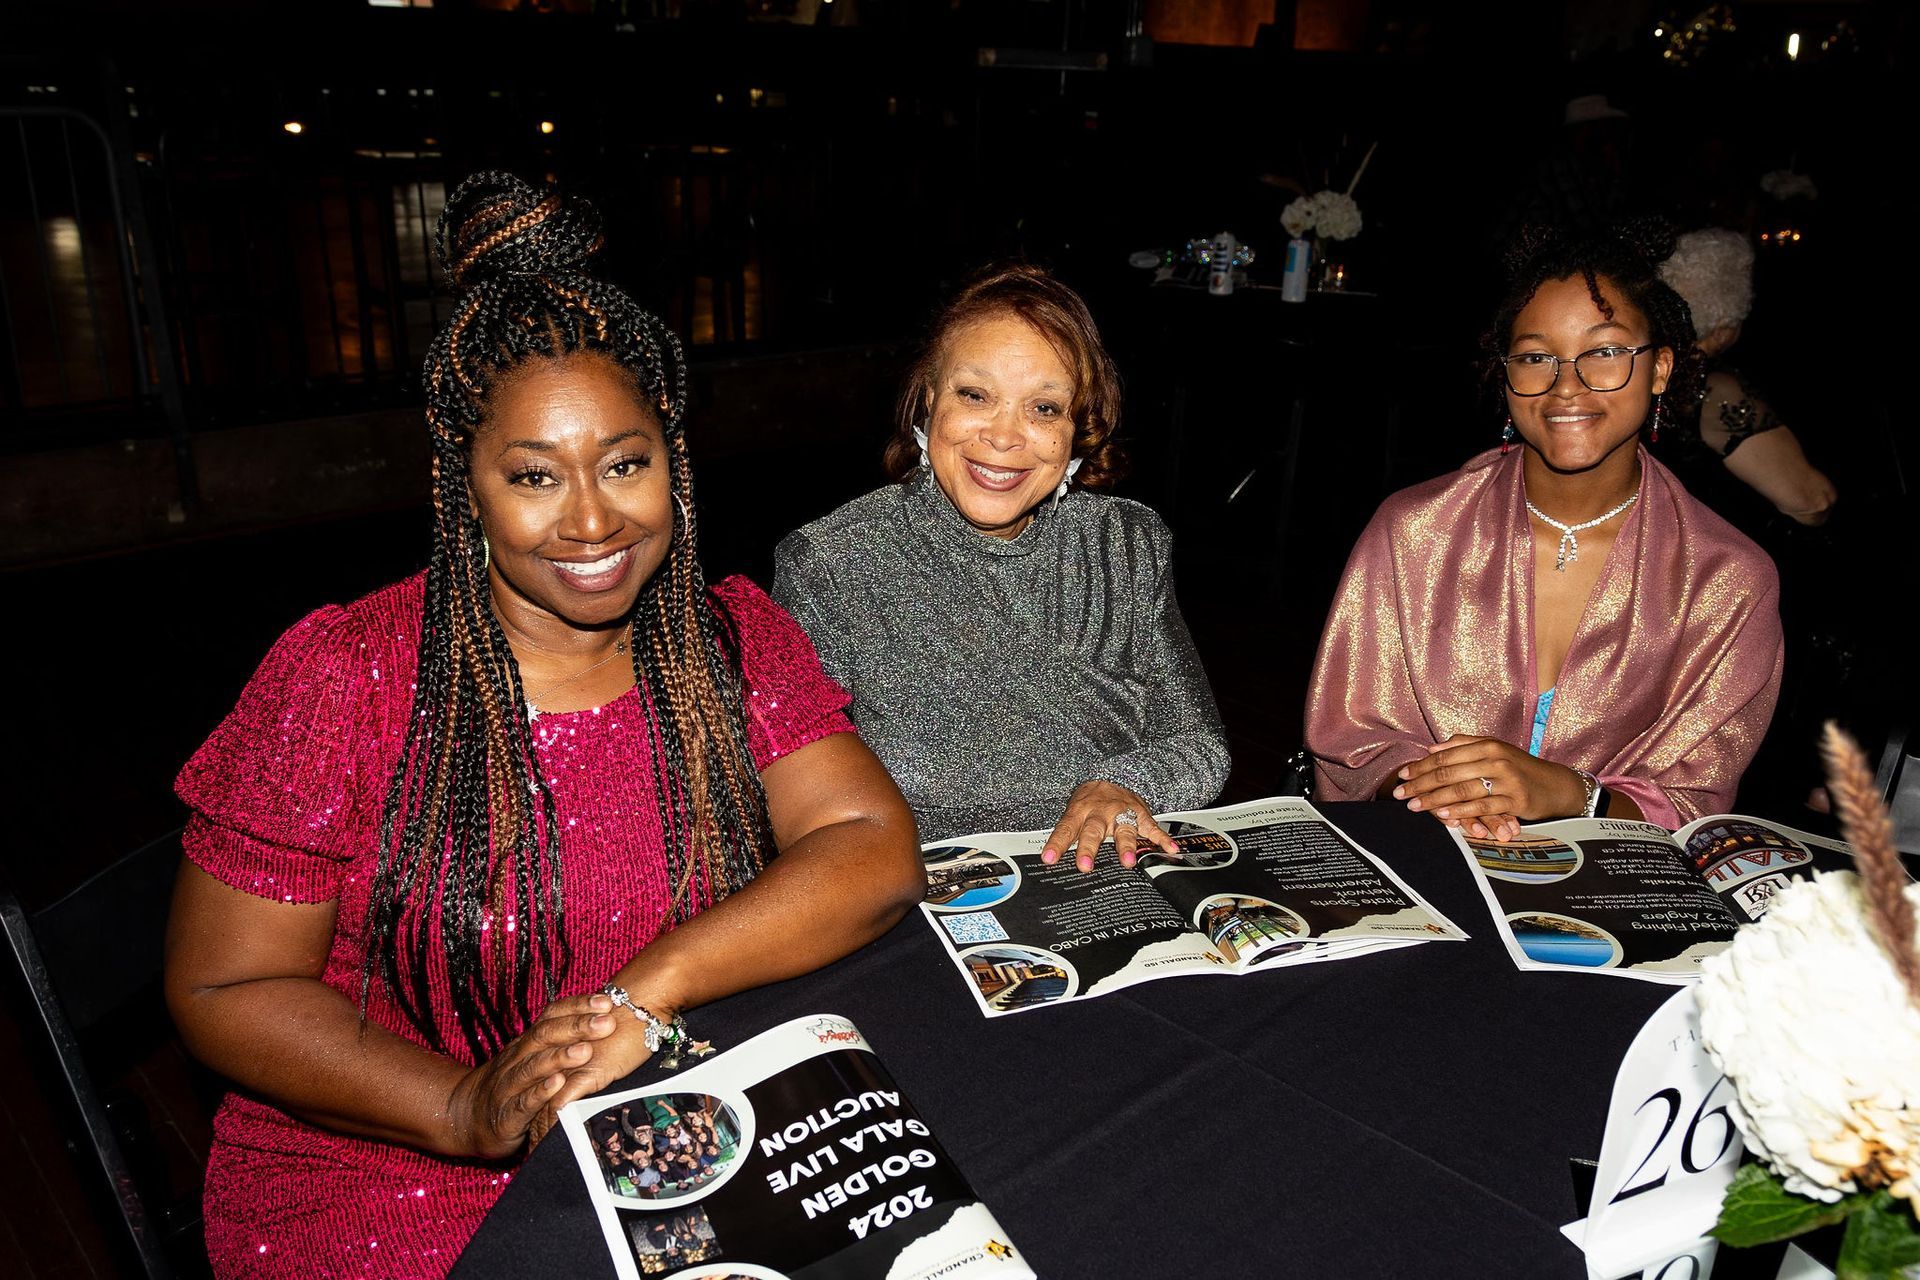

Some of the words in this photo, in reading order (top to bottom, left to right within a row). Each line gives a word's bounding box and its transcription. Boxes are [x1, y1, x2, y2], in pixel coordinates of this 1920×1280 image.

[1216, 810, 1275, 822] Productions
[1599, 822, 1639, 832] BUILT
[1190, 835, 1224, 844] PIRATE
[1205, 841, 1230, 850] CHS
[1090, 882, 1130, 894] Details:
[1281, 878, 1382, 890] Advertisement
[1332, 888, 1395, 898] Network
[1310, 898, 1360, 907] Sports
[1360, 897, 1406, 906] Pirate
[1640, 910, 1698, 922] Anglers
[1113, 923, 1146, 936] STAY
[1150, 920, 1192, 930] 7-DAY
[1632, 922, 1688, 932] Fishing
[1094, 930, 1110, 940] IN
[1050, 936, 1092, 952] CABO
[759, 1090, 900, 1157] AUCTION
[840, 1119, 930, 1153] GALA
[1608, 1073, 1737, 1205] 26
[766, 1146, 839, 1194] LIVE
[801, 1149, 936, 1219] GOLDEN
[847, 1186, 933, 1240] 2024
